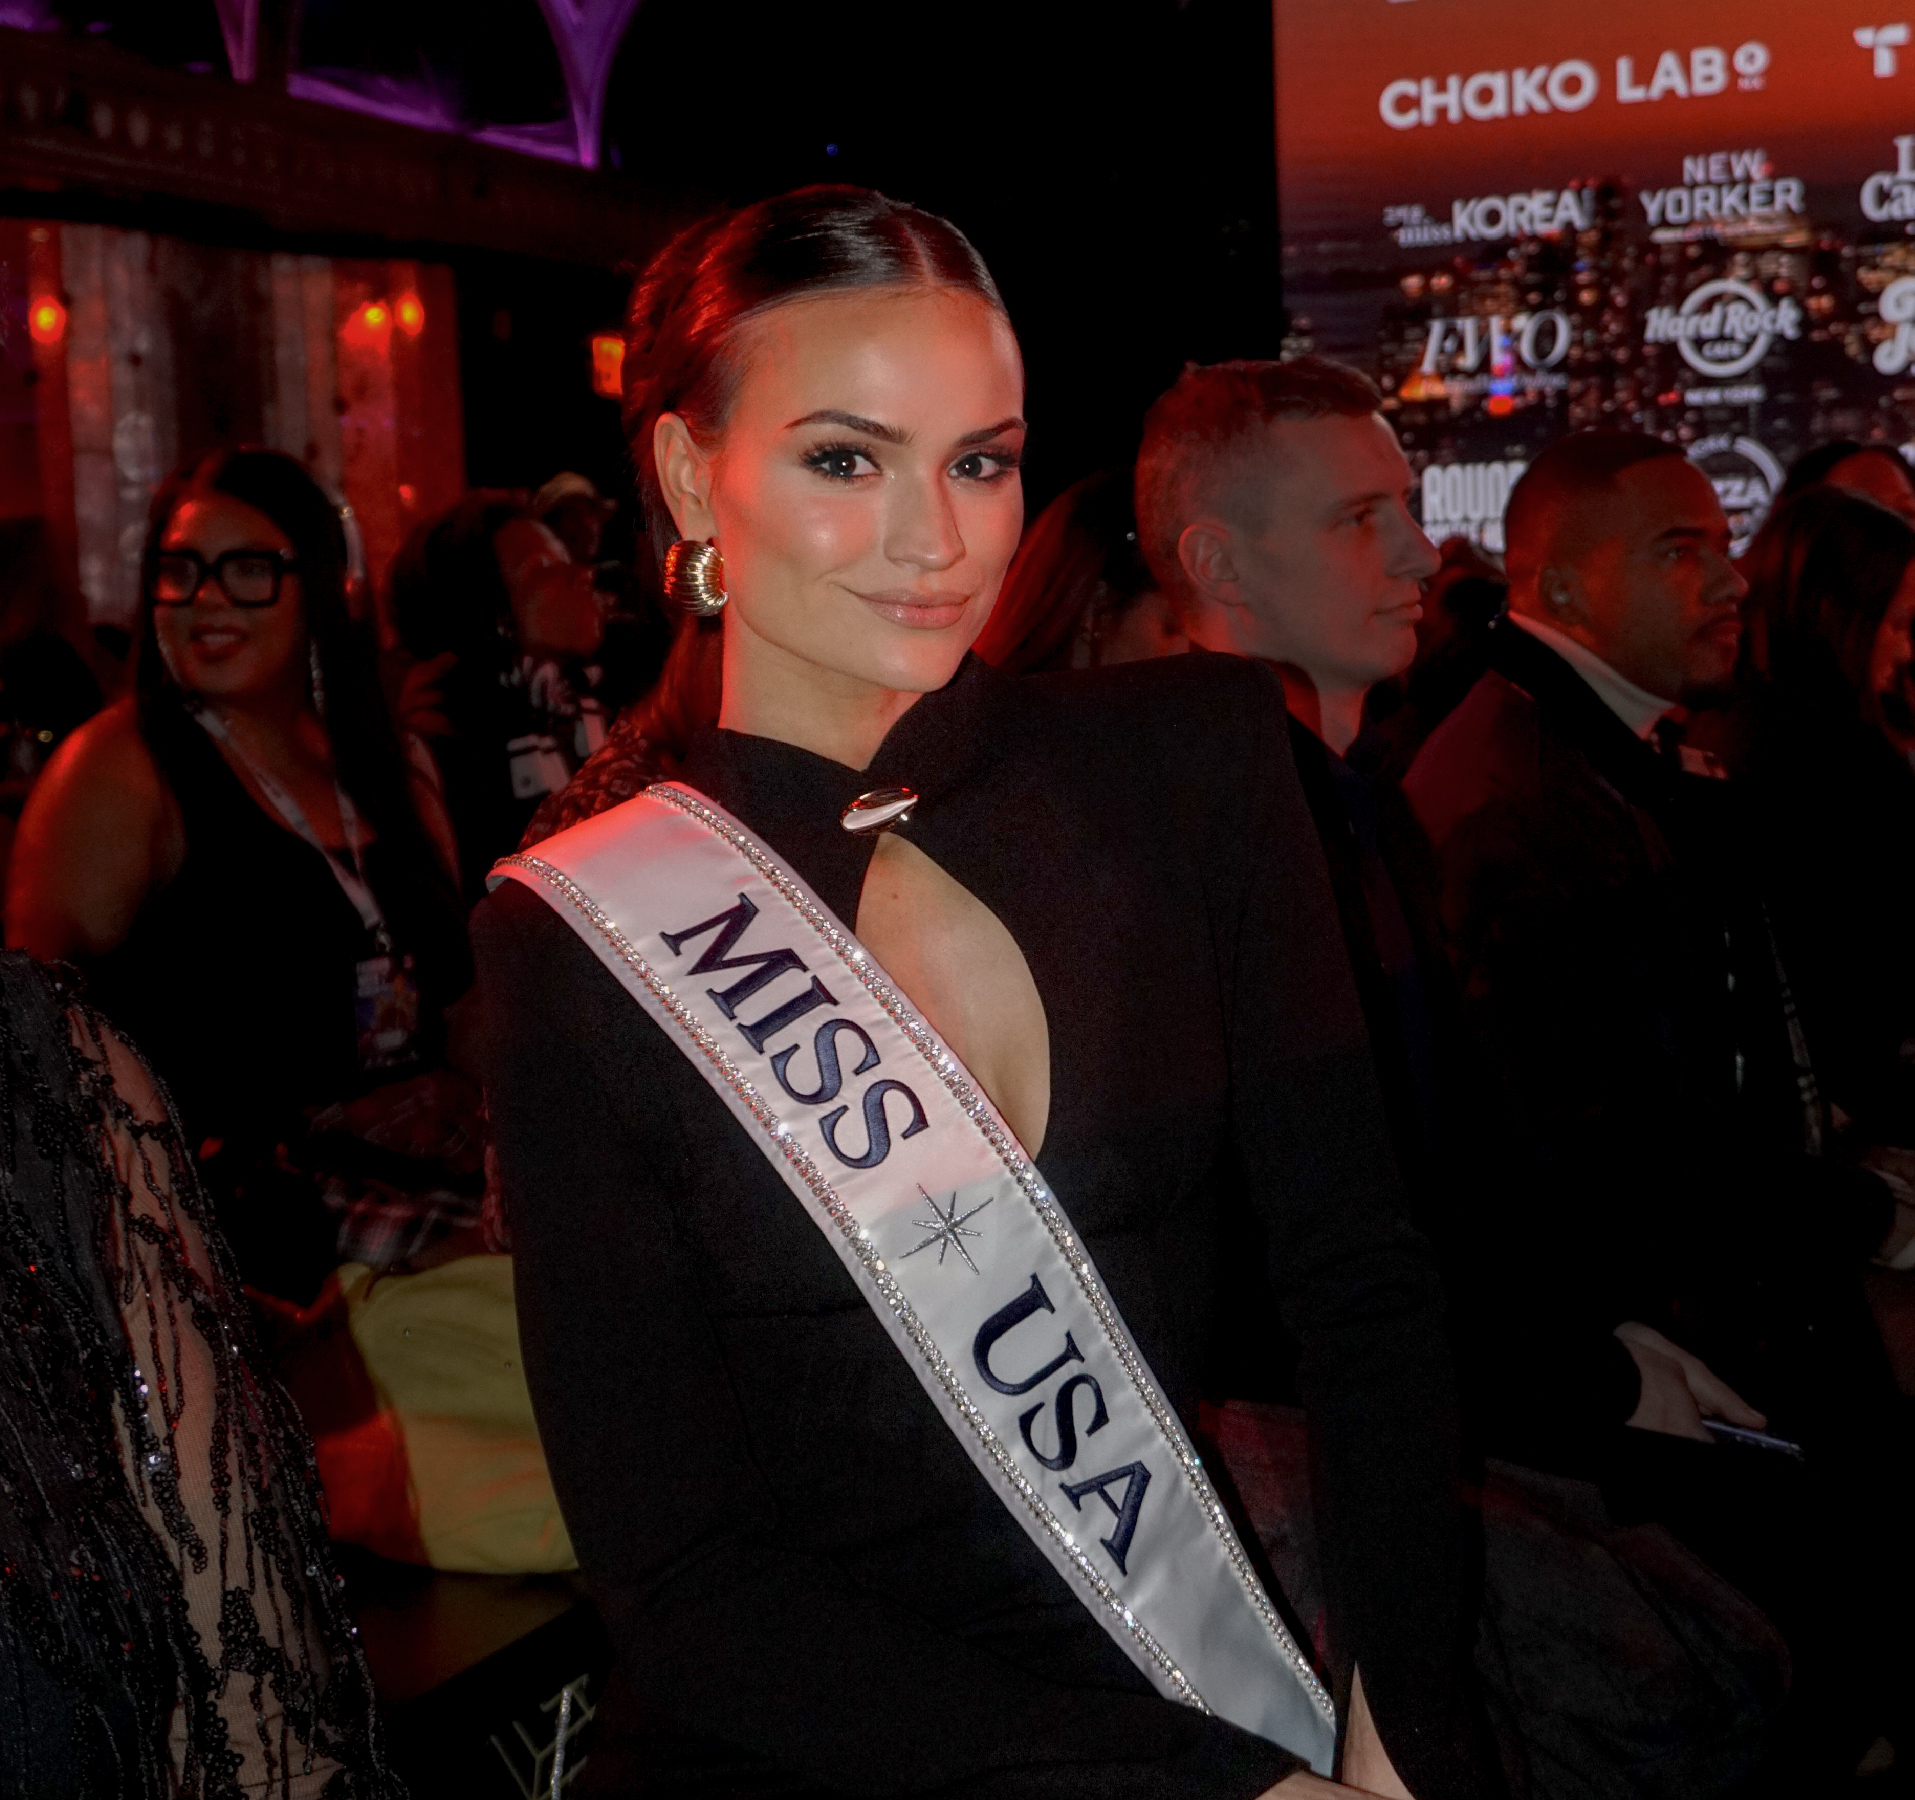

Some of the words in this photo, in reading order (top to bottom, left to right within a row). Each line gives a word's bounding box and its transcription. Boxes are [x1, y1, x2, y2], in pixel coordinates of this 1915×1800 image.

[1682, 148, 1768, 186] NEW
[1639, 176, 1805, 227] YORKER
[1643, 302, 1724, 344] Hard
[1722, 297, 1801, 343] Rock
[660, 892, 929, 1171] MISS
[971, 1273, 1152, 1577] USA
